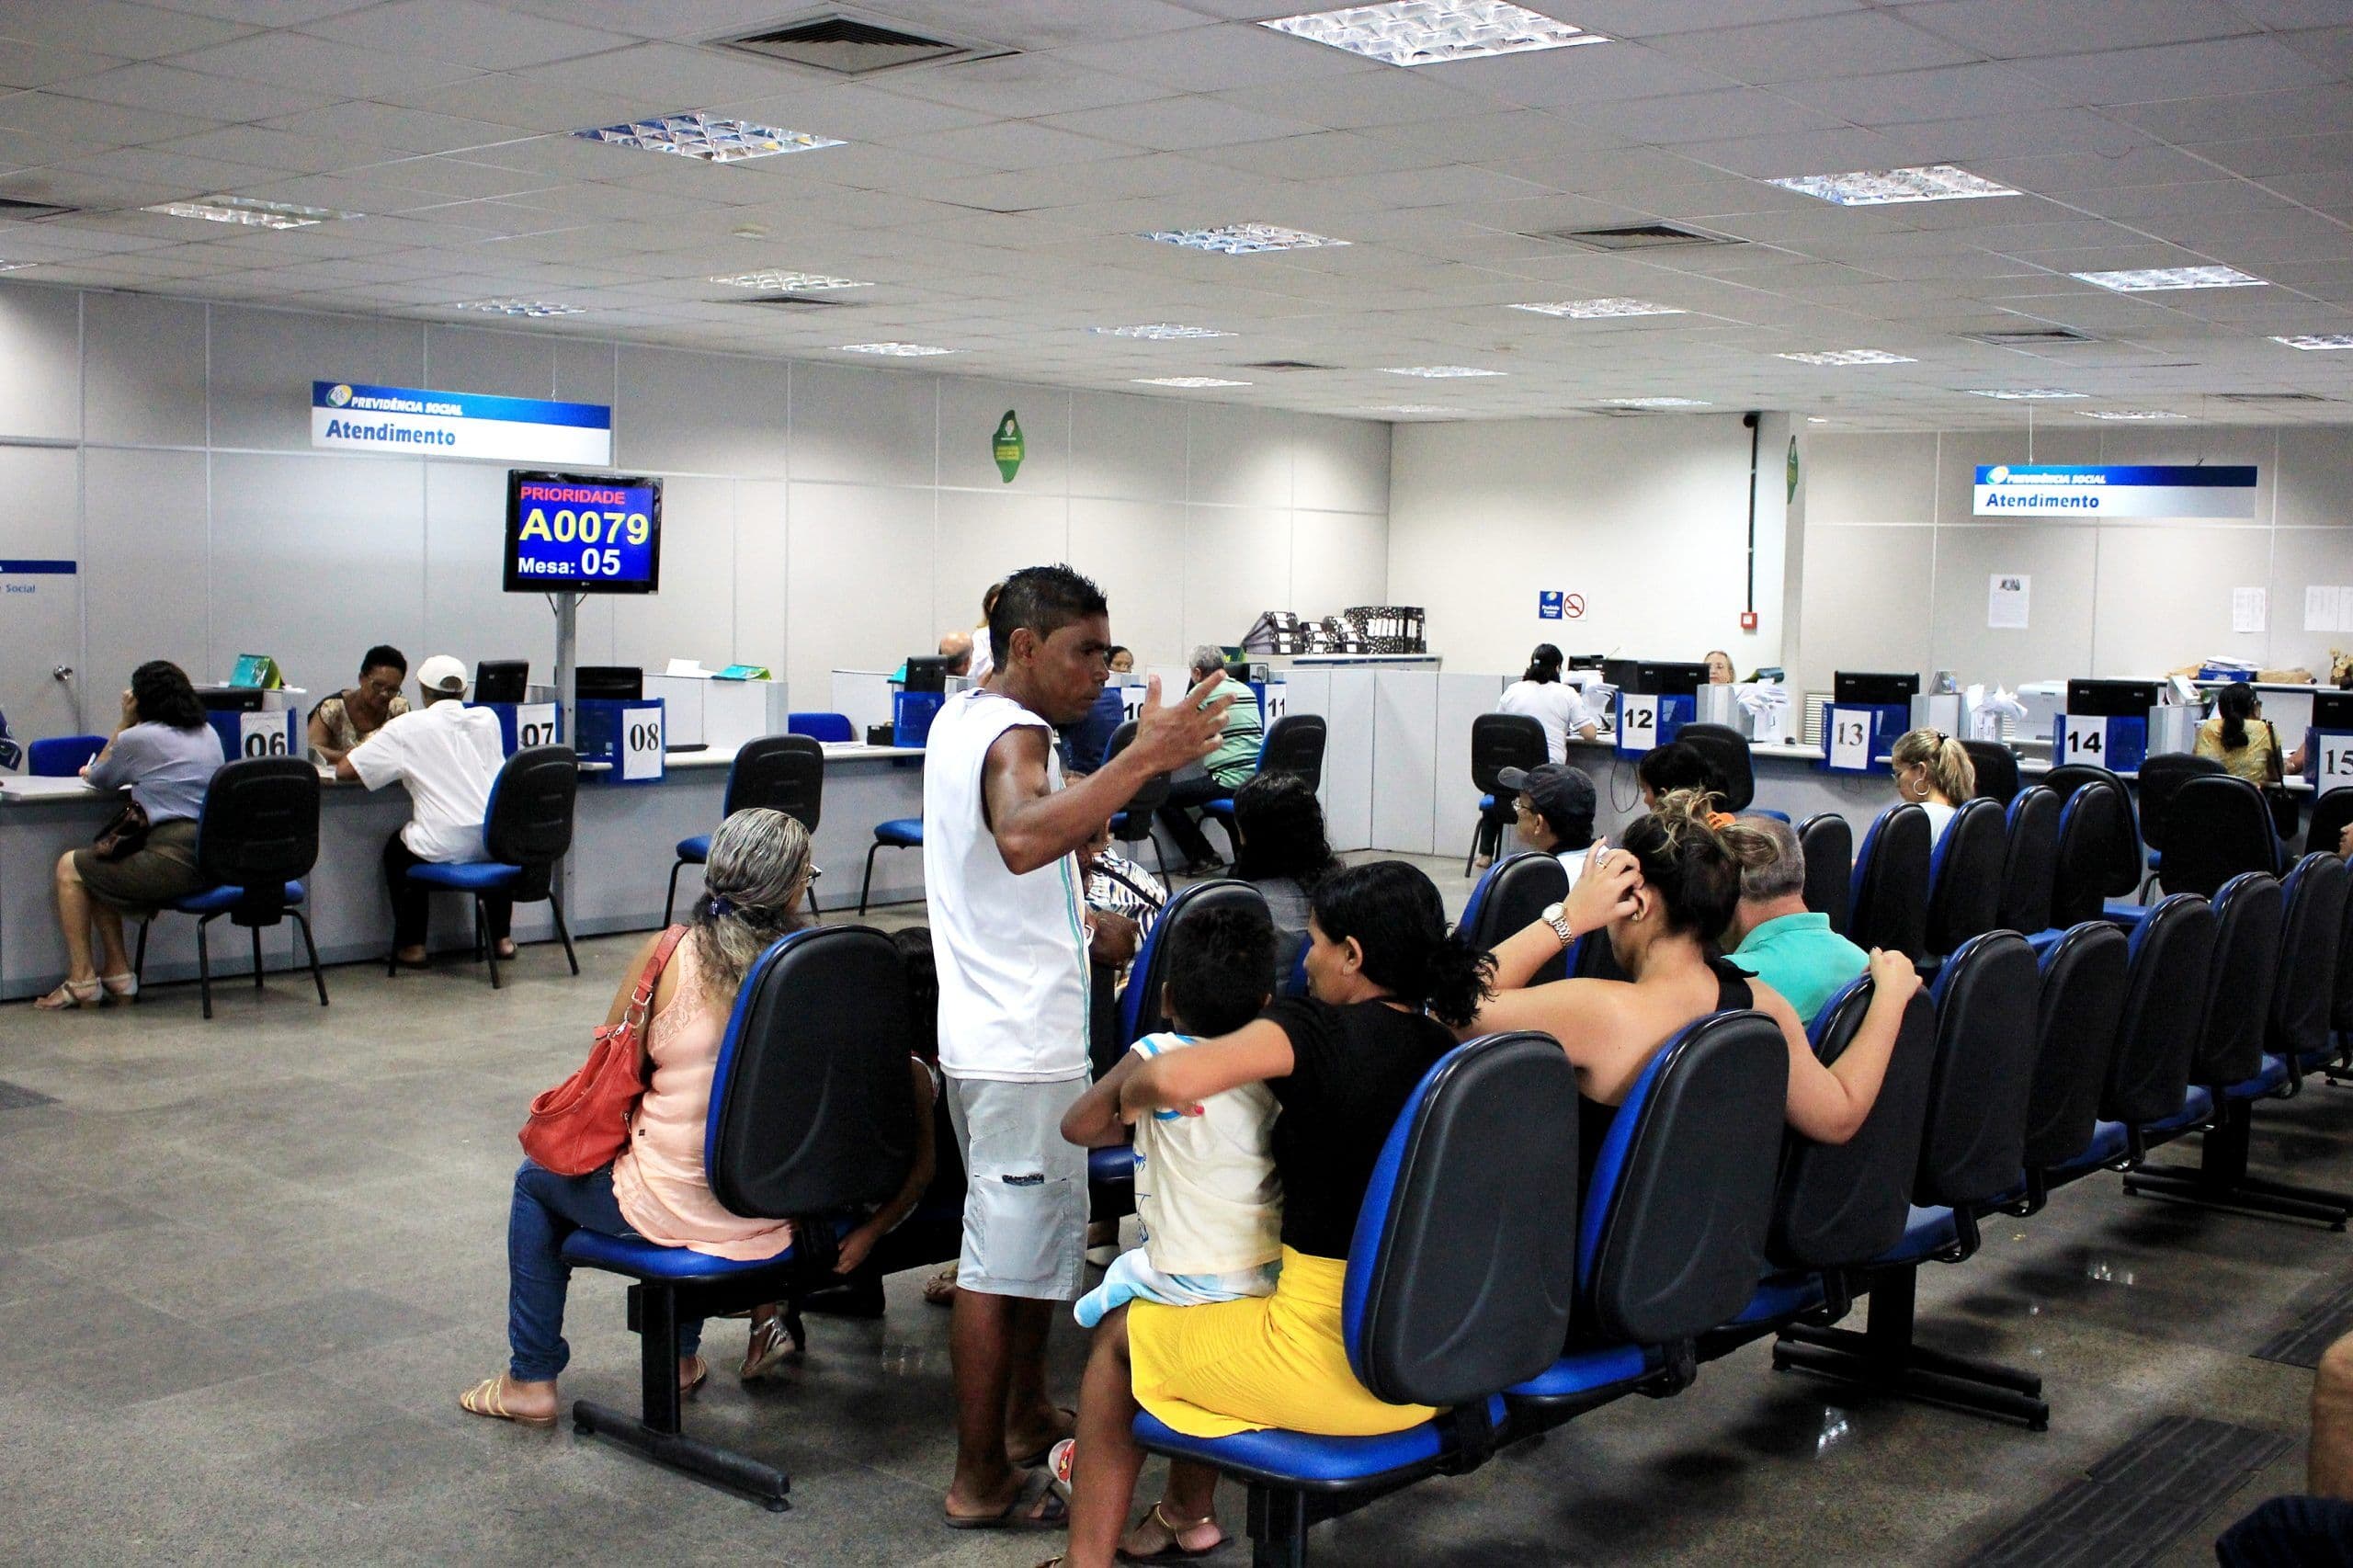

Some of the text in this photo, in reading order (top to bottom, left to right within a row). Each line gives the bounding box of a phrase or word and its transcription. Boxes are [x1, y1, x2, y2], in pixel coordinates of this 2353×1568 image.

[350, 395, 463, 416] PREVIDÊNCIA SOCIAL
[325, 419, 457, 446] Atendimento
[2071, 474, 2107, 484] SOCIAL
[520, 486, 626, 506] PRIORIDADE
[1985, 493, 2100, 508] Atendimento
[518, 508, 649, 545] A0079
[517, 548, 621, 575] Mesa: 05
[6, 584, 36, 593] Social
[1624, 709, 1654, 729] 12
[244, 732, 286, 758] 06
[522, 722, 553, 748] 07
[630, 722, 659, 752] 08
[1837, 722, 1864, 746] 13
[2067, 731, 2102, 754] 14
[2325, 748, 2353, 776] 15
